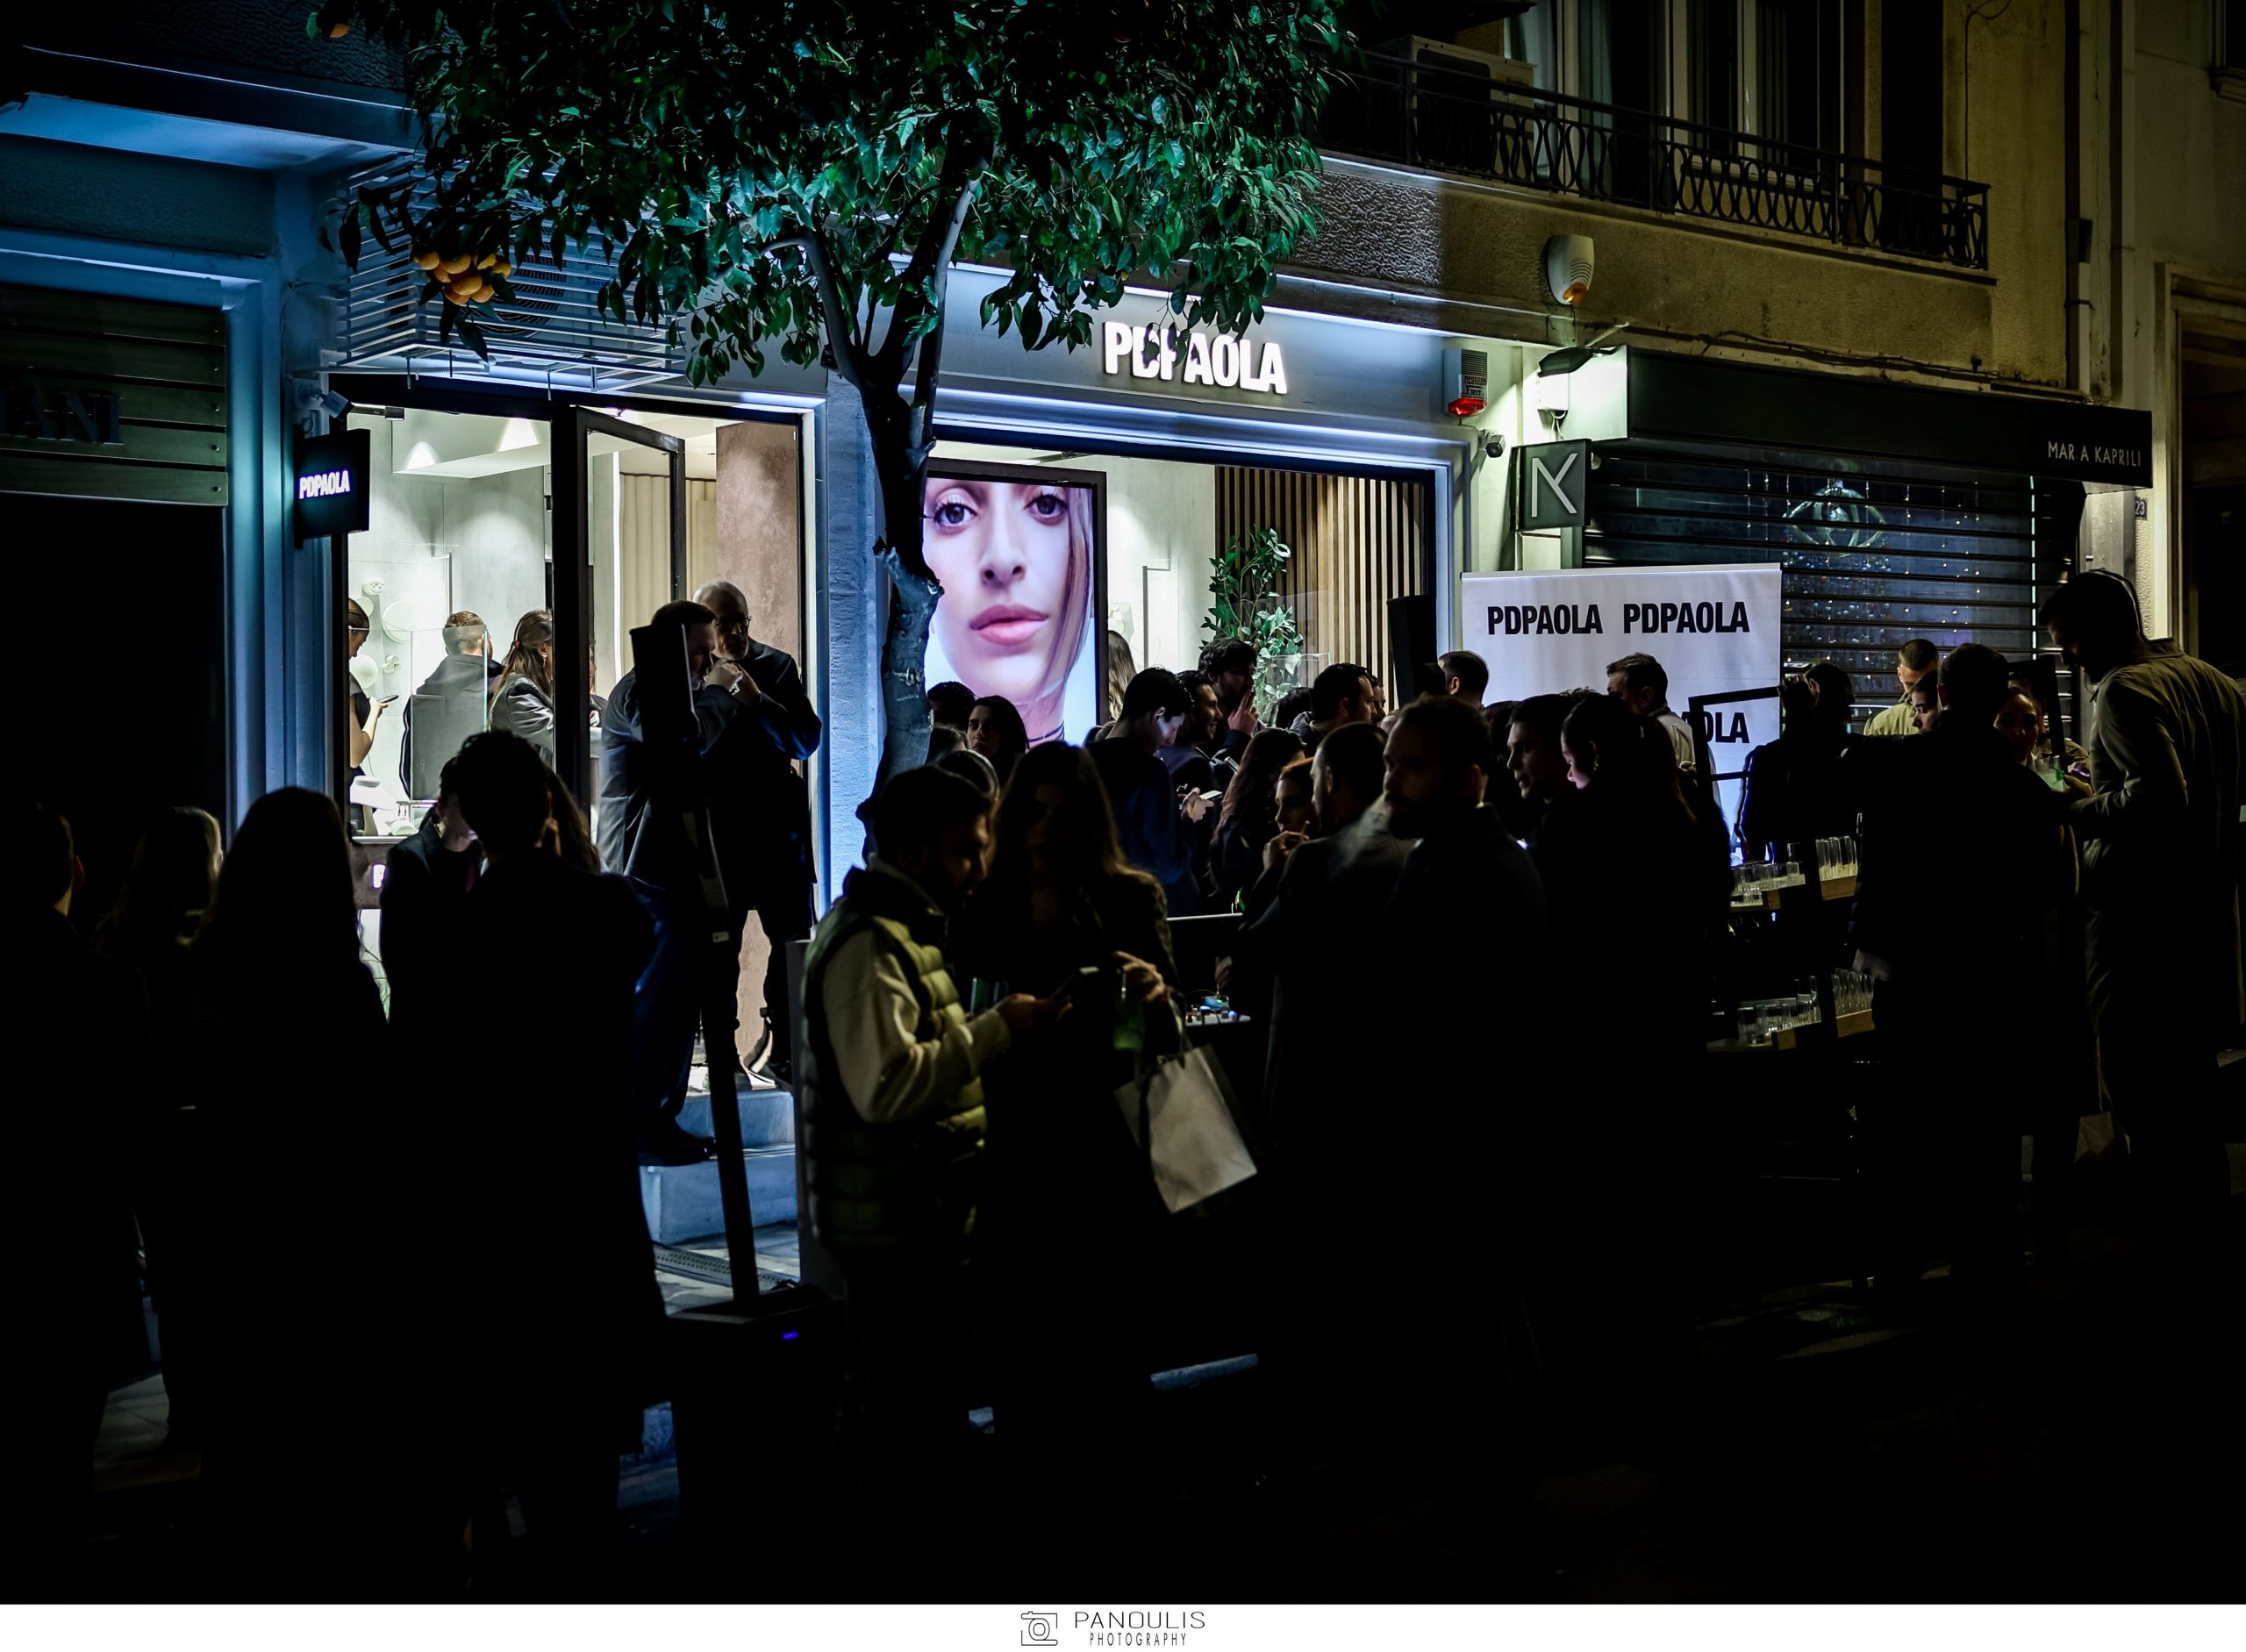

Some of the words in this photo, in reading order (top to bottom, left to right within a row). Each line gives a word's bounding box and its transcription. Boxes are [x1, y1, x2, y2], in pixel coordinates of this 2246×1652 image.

[2094, 446, 2141, 467] KAPRILI
[298, 469, 351, 499] PDPAOLA
[1487, 604, 1604, 635] PDPAOLA
[1623, 601, 1750, 633] PDPAOLA
